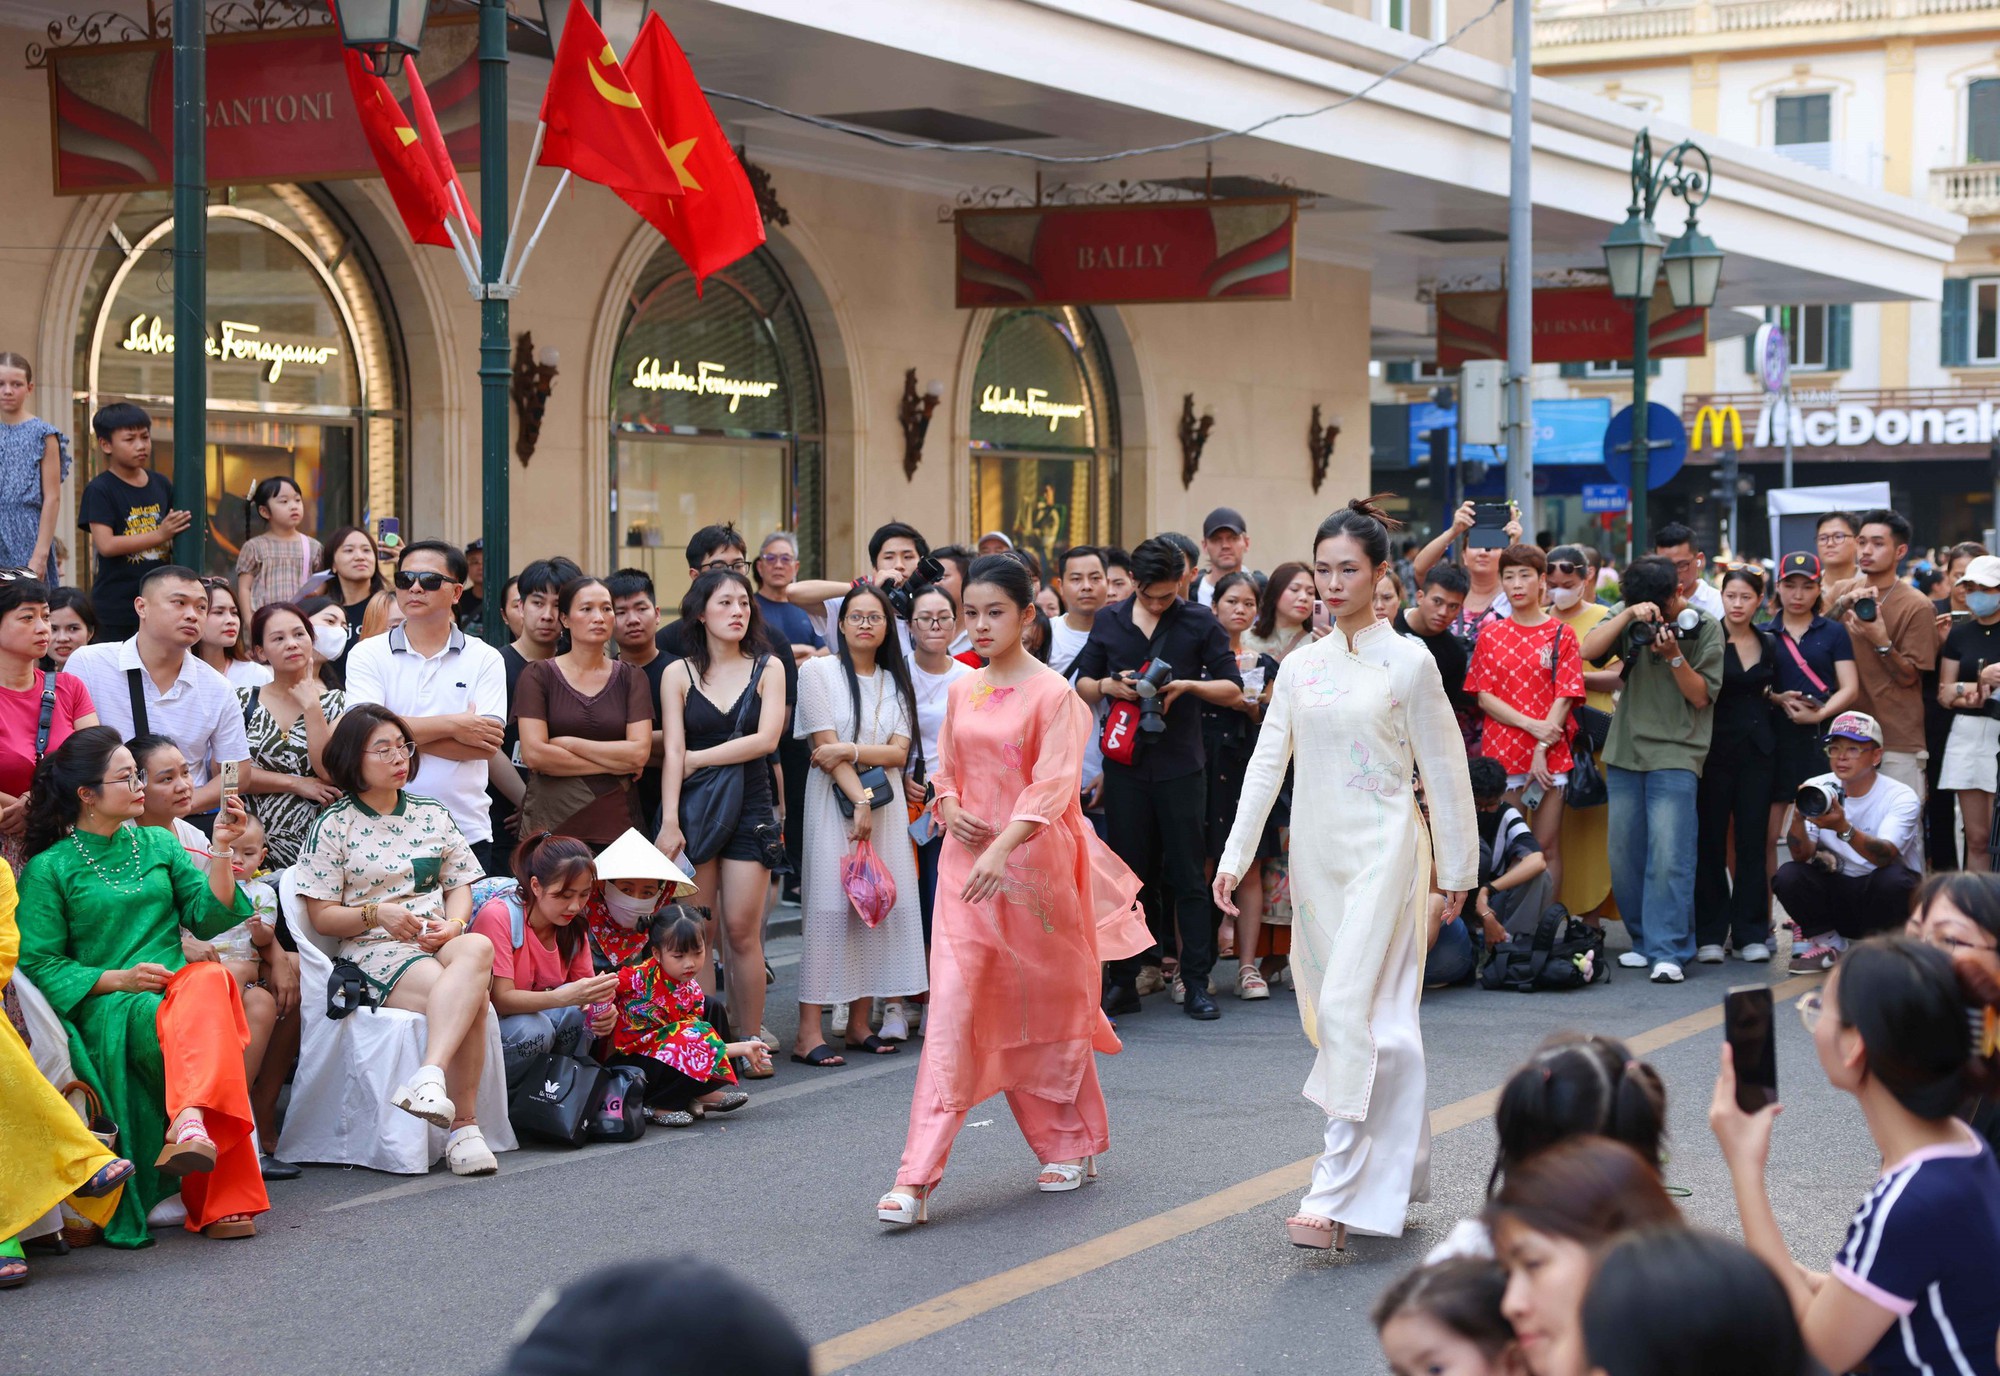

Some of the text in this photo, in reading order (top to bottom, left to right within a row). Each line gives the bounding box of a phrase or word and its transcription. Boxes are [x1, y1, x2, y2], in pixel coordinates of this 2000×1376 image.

[206, 91, 334, 127] ANTONI
[1078, 243, 1171, 270] BALLY
[221, 320, 339, 384] Ferragamo
[632, 356, 778, 414] Salvatore Ferragamo
[980, 384, 1086, 433] Salvatore Ferragamo
[1107, 710, 1128, 750] FILA
